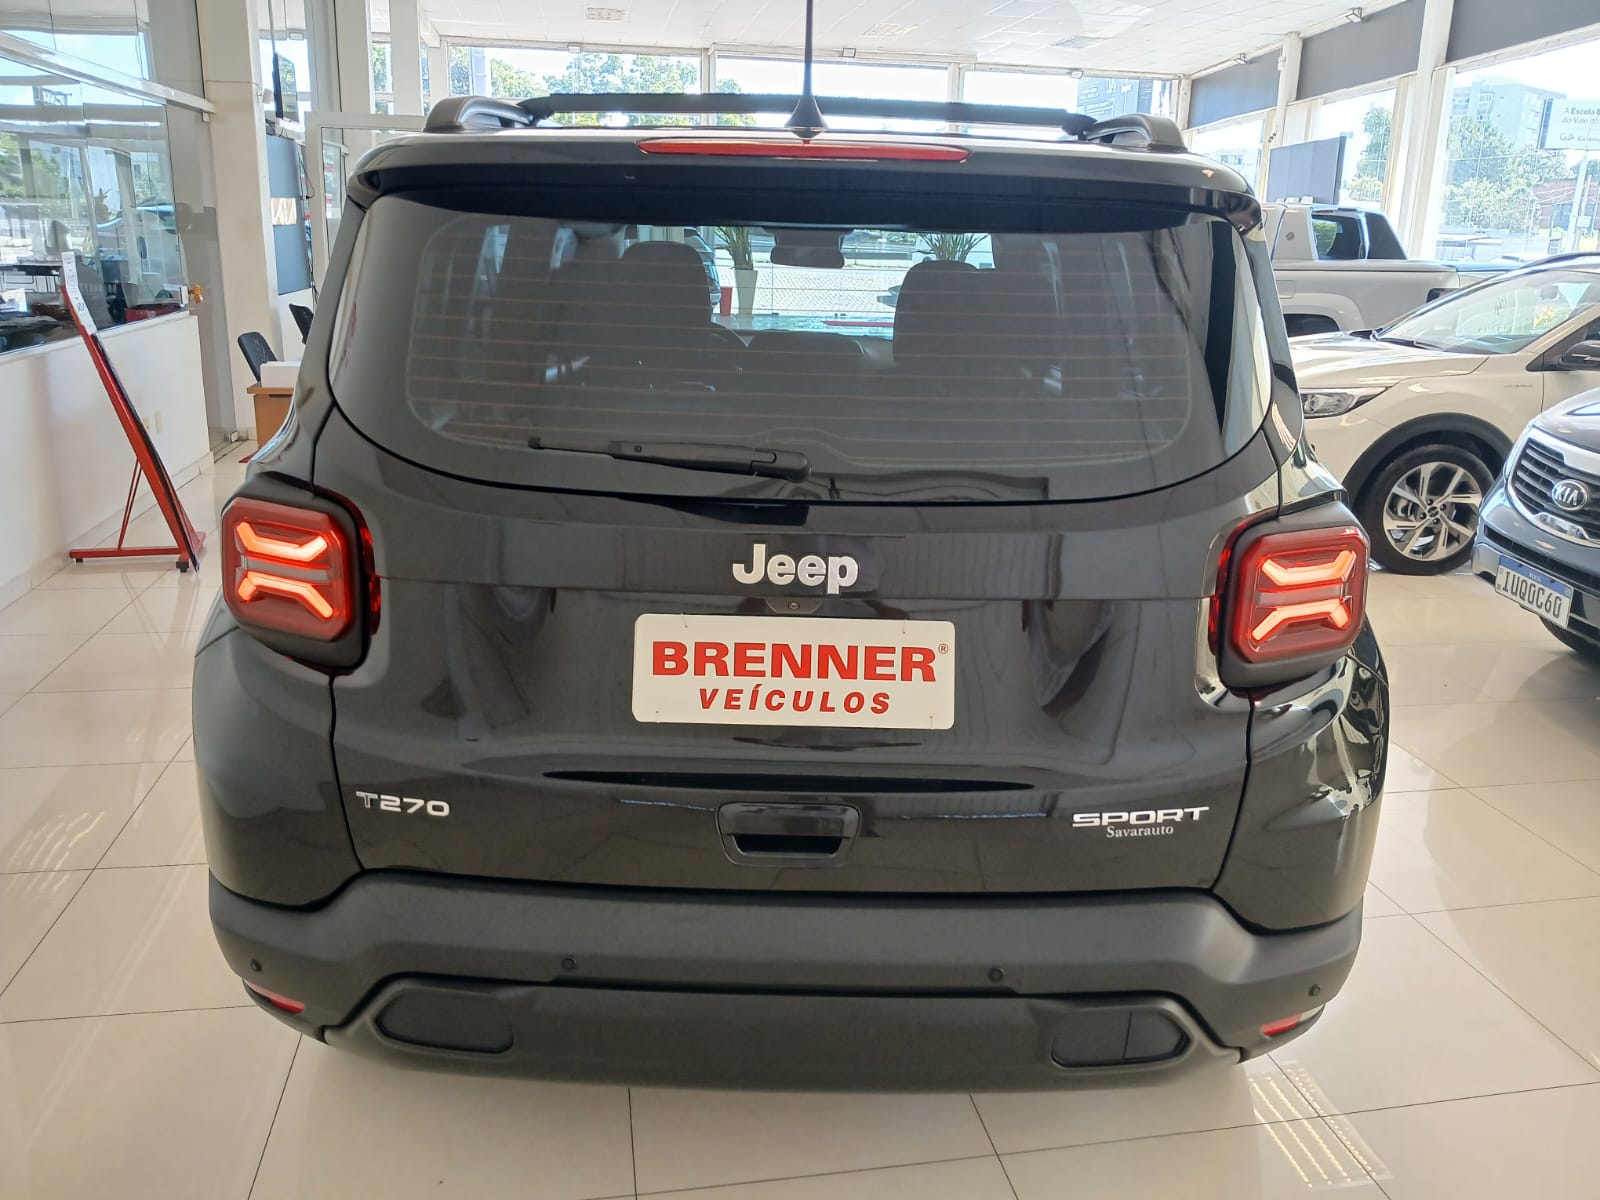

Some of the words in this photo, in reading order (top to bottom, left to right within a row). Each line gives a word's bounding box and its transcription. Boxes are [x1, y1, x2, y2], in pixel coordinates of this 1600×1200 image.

[1555, 485, 1578, 505] KIA
[731, 543, 859, 596] Jeep
[699, 683, 891, 715] VEÍCULOS
[355, 790, 450, 817] T270
[1072, 806, 1210, 828] SPORT
[1106, 825, 1174, 839] Savarauto
